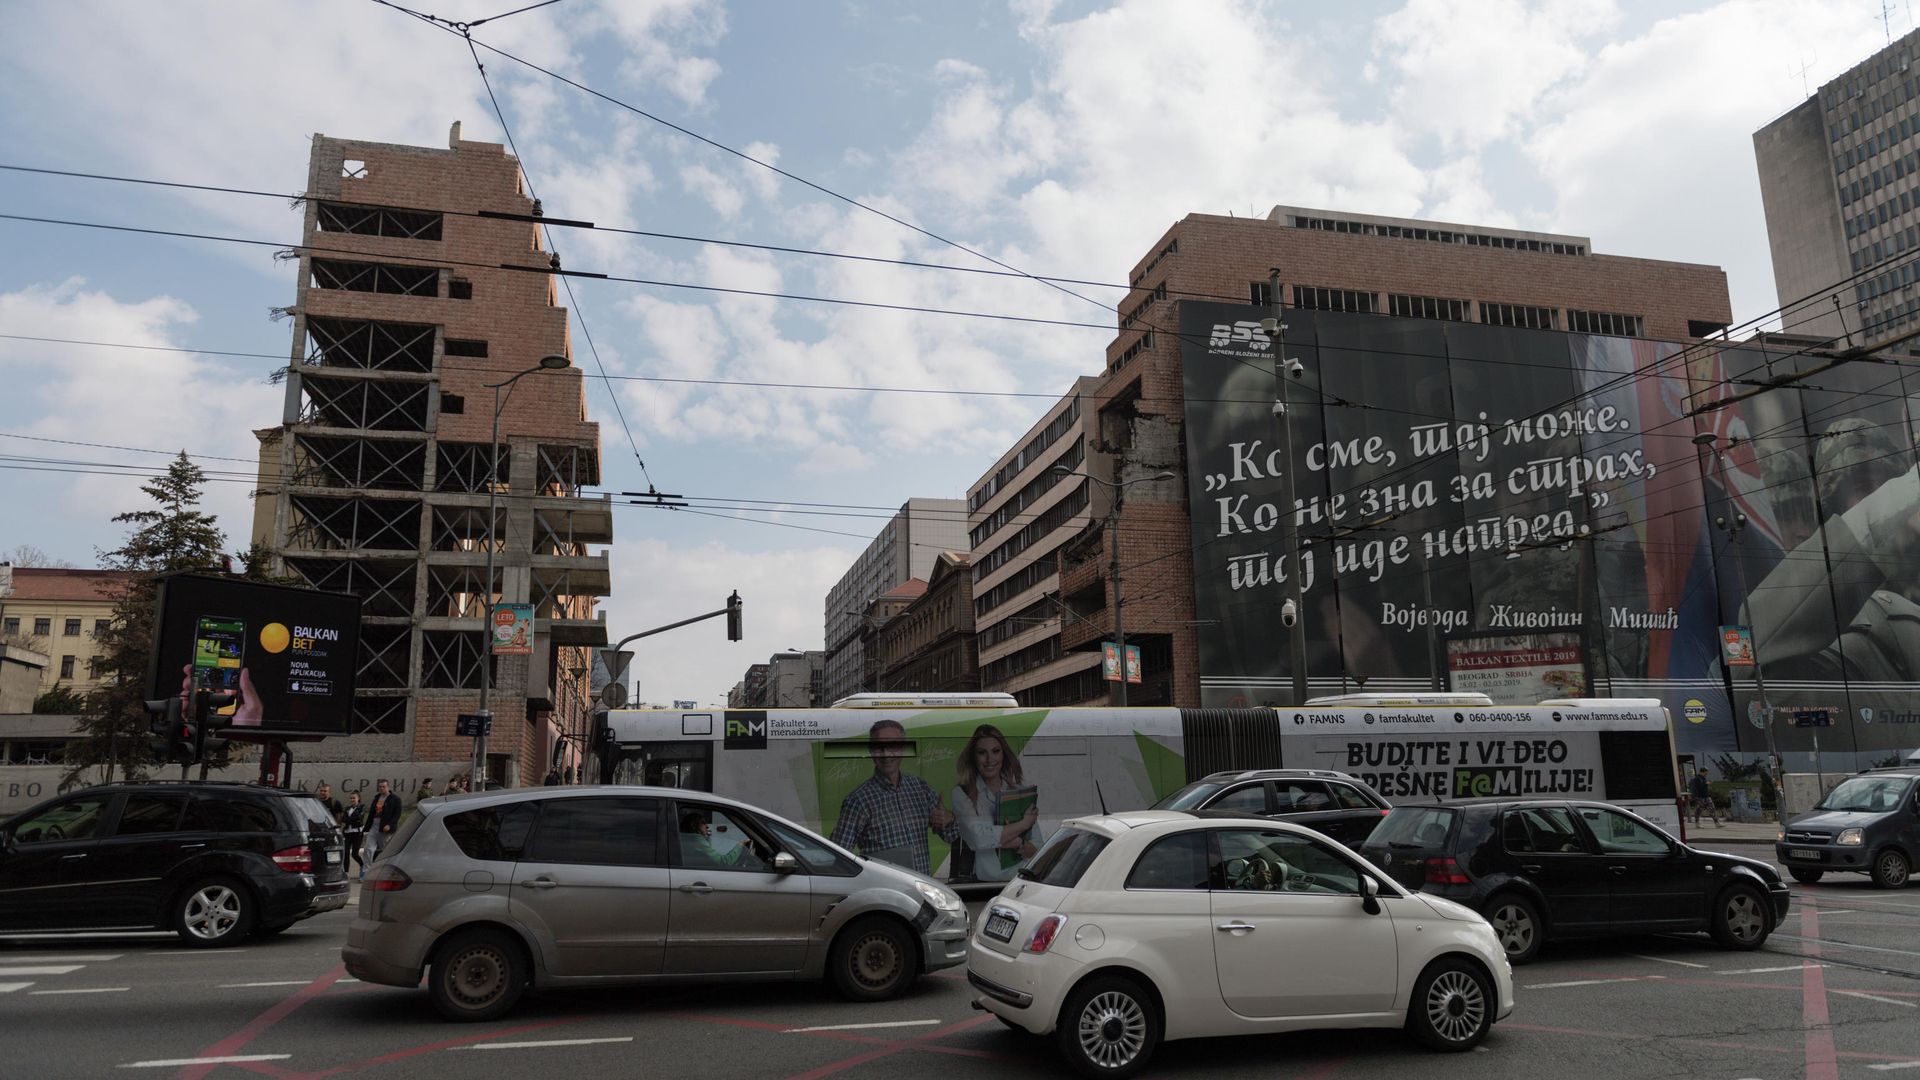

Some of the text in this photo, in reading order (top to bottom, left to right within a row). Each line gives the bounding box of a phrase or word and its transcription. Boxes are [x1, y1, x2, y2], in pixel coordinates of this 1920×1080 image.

[1306, 435, 1396, 472] сме,
[1503, 405, 1630, 446] може.
[1215, 493, 1279, 537] Ко
[1295, 493, 1347, 527] не
[1359, 480, 1438, 517] зна
[1449, 471, 1497, 502] за
[1335, 535, 1411, 583] иде
[294, 626, 339, 641] BALKAN
[292, 638, 316, 650] BET
[290, 661, 309, 669] NOVA
[1456, 651, 1576, 667] BALKAN TEXTILE 2019
[290, 669, 327, 678] APLIKACIJA
[1458, 669, 1499, 681] BEOGRAD
[1309, 714, 1345, 724] FAMNS
[1379, 713, 1435, 724] famfakultet
[1469, 712, 1532, 722] 060-0400-156
[1565, 711, 1649, 722] www.famns.edu.rs
[726, 720, 766, 737] FAM
[770, 719, 806, 728] Fakultet
[770, 727, 831, 737] menadžment
[1347, 740, 1568, 767] BUDITE I VI DEO
[1349, 766, 1448, 797] PEŠNE
